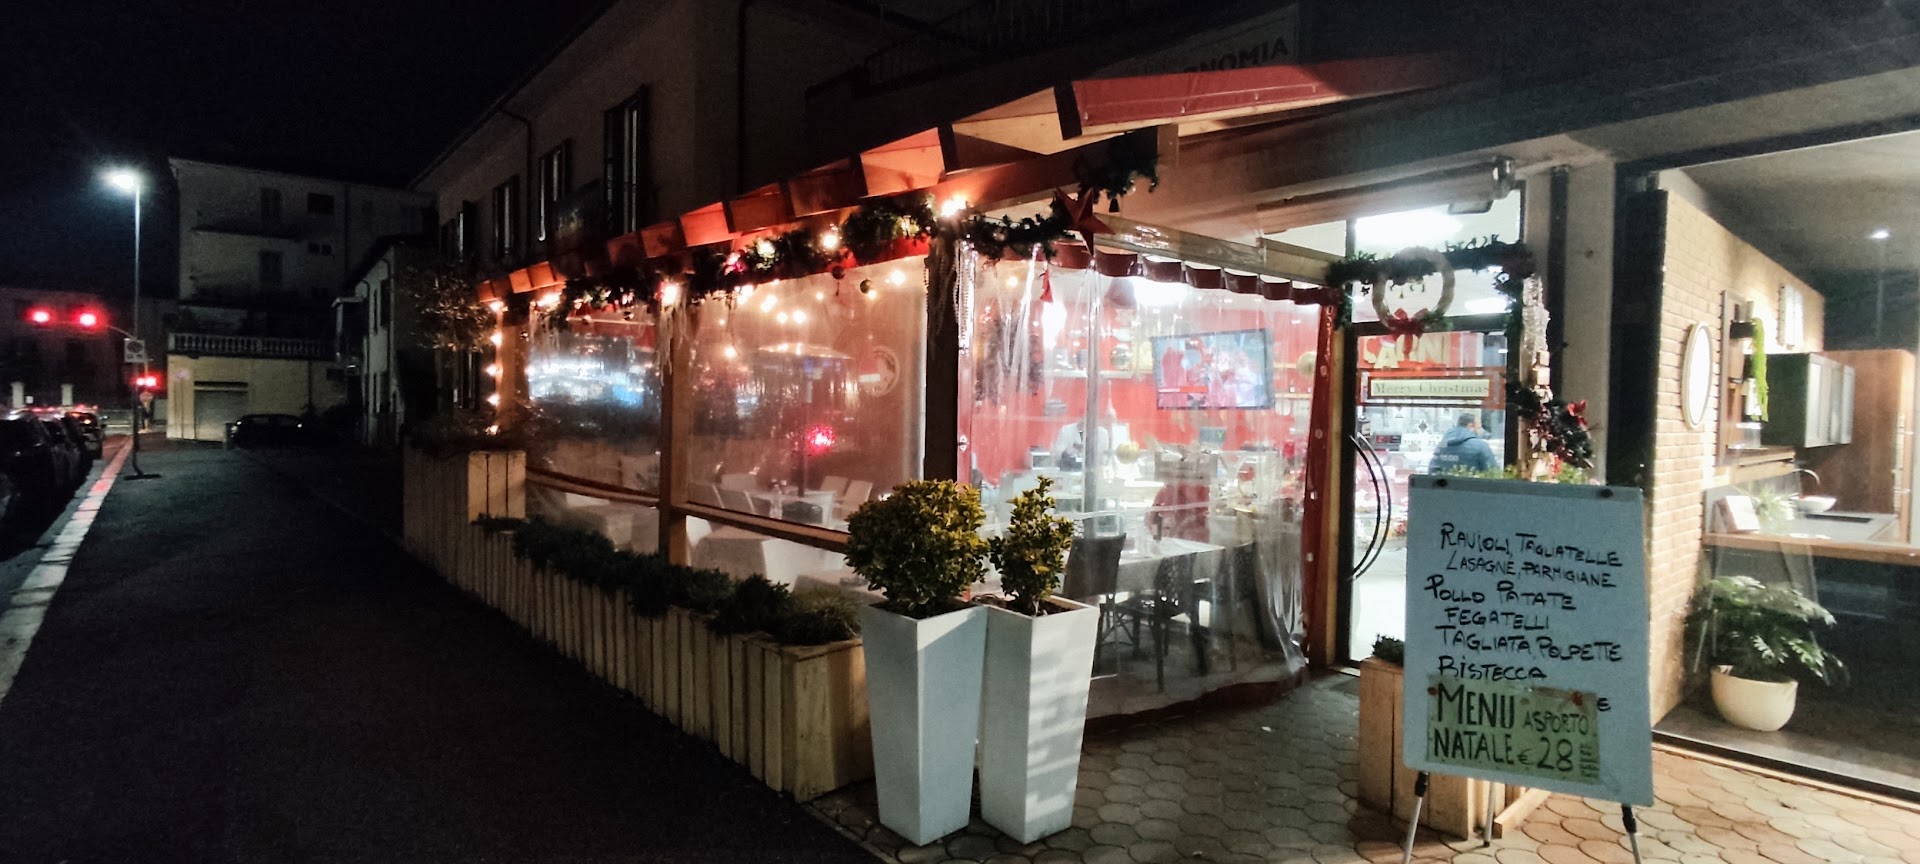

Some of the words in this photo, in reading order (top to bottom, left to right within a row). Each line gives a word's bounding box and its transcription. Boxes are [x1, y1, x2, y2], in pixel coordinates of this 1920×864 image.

[1375, 382, 1411, 396] Merry
[1418, 381, 1489, 394] Christmas
[1515, 532, 1623, 566] TAGLIATELLE
[1521, 561, 1617, 588] PARMIGIANE
[1424, 574, 1486, 603] POLLO
[1496, 580, 1577, 610] PATATE
[1444, 606, 1550, 630] FEGATELLI
[1536, 636, 1622, 661] POLPETTE
[1437, 682, 1516, 729] MENU
[1523, 710, 1590, 736] ASPORTO
[1434, 727, 1515, 766] NATALE
